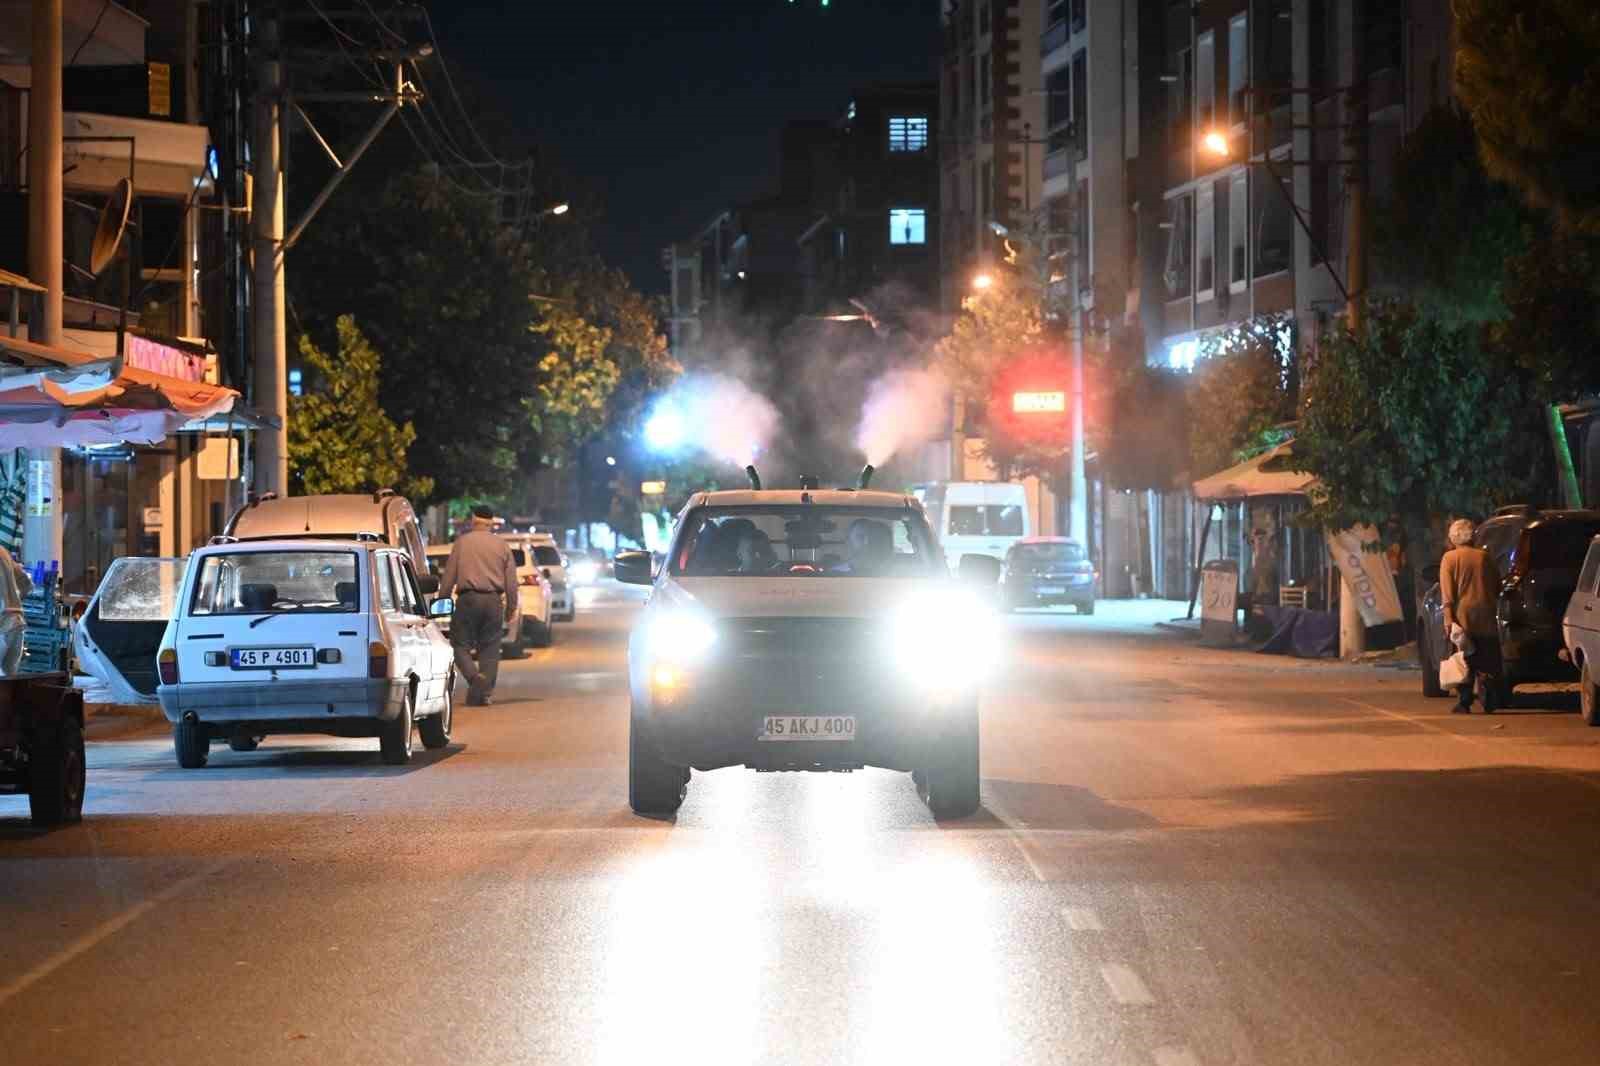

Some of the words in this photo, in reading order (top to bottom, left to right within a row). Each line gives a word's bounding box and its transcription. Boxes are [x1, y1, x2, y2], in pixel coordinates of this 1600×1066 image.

[240, 651, 257, 665] 45
[262, 652, 270, 665] P
[276, 650, 308, 664] 4901
[767, 718, 785, 735] 45
[790, 718, 819, 735] AKJ
[824, 718, 854, 735] 400
